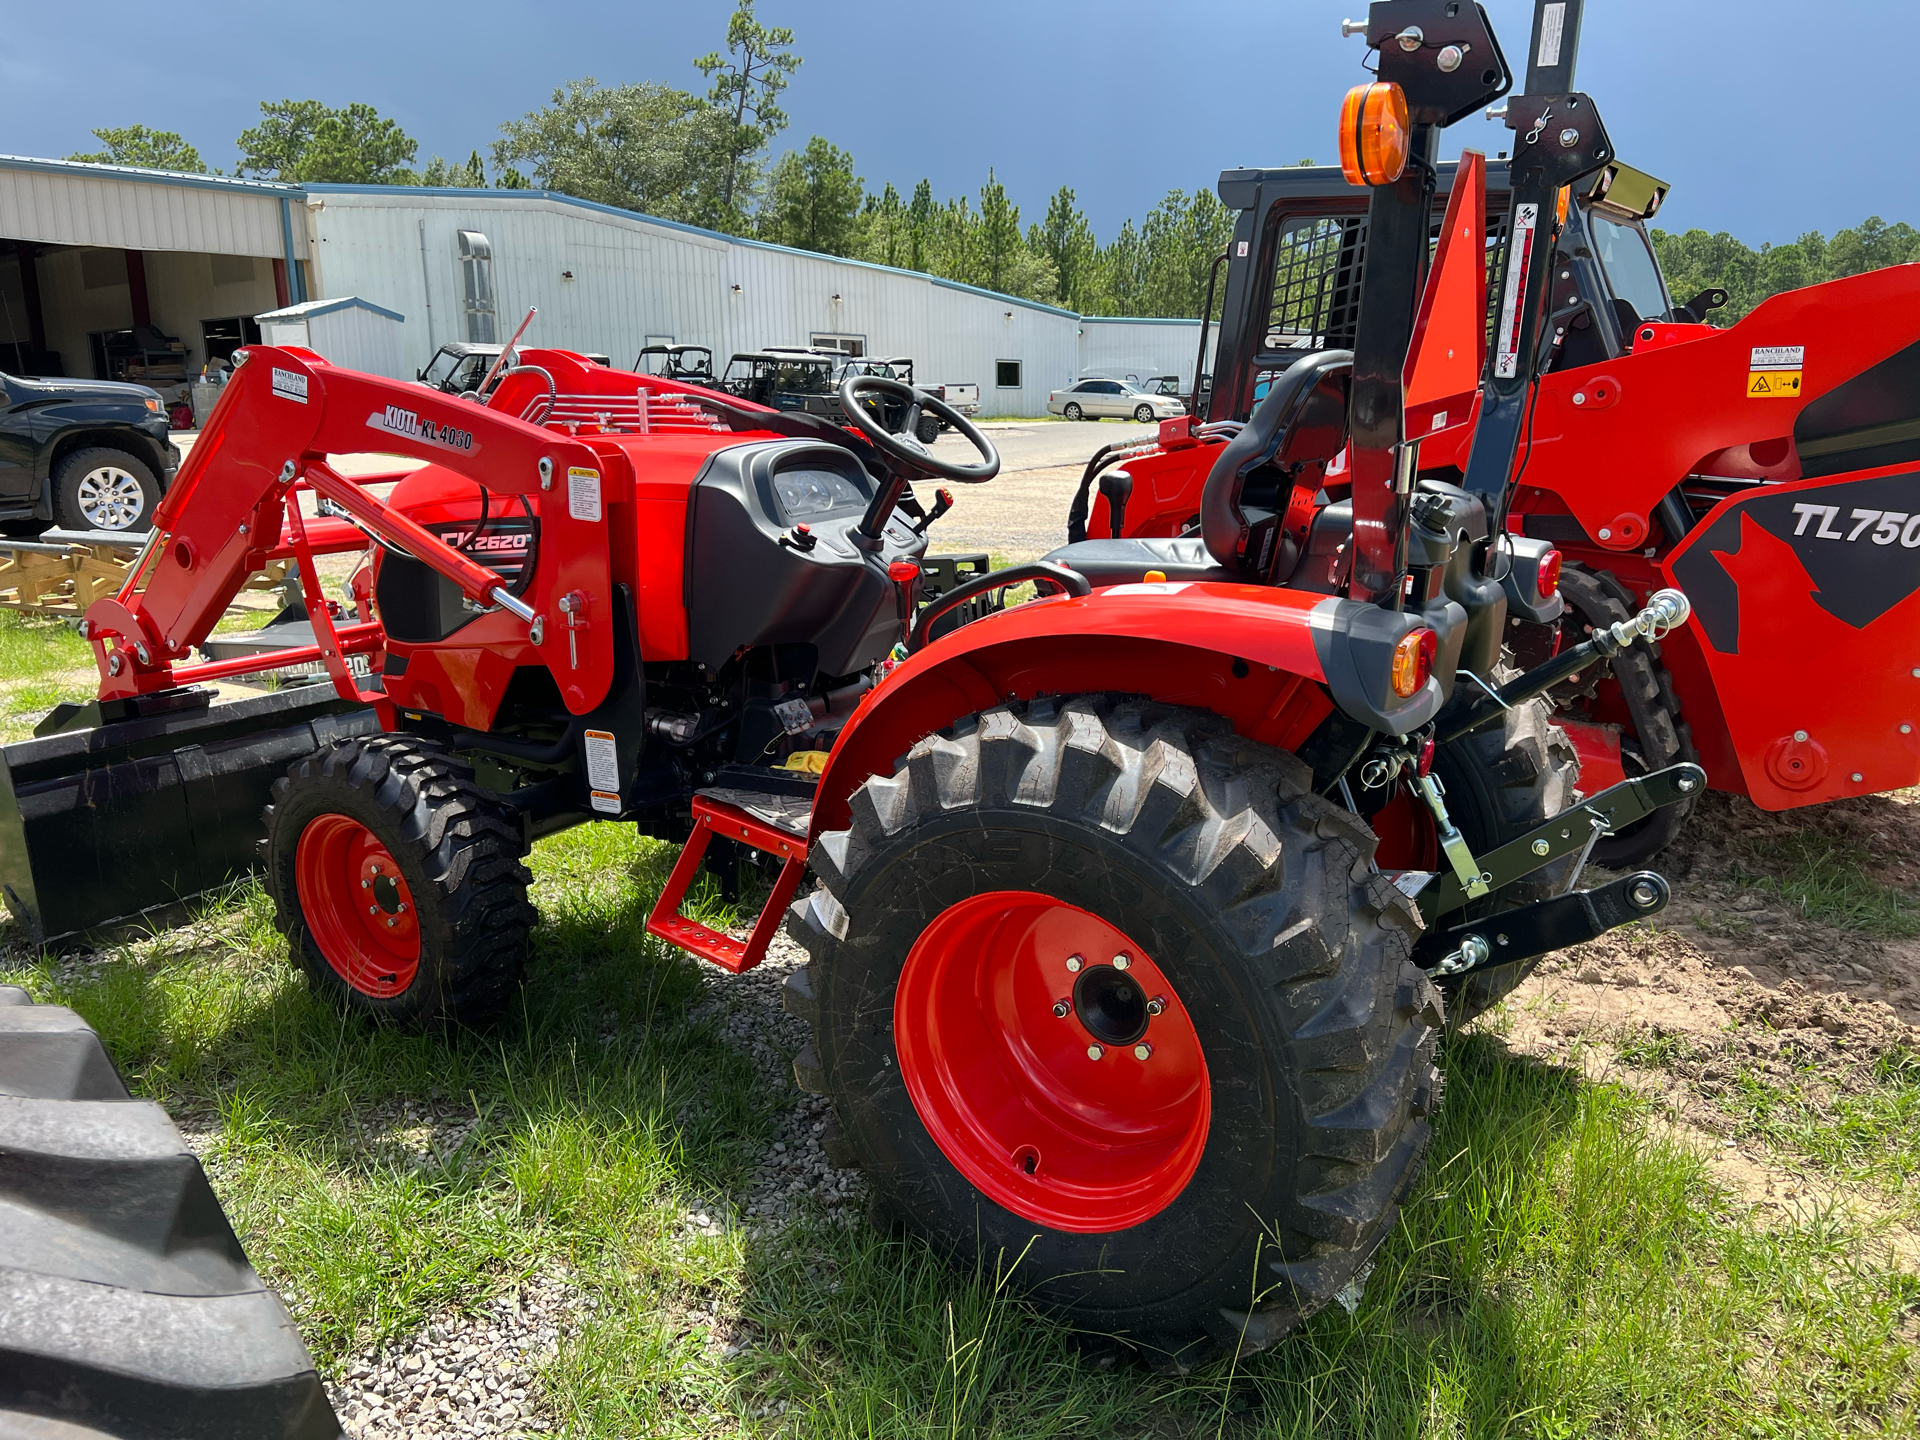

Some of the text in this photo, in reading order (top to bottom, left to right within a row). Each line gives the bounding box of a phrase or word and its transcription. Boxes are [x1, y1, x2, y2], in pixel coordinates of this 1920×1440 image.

[1511, 254, 1530, 348] DANGER
[1755, 347, 1801, 355] RANCHLAND
[274, 368, 306, 384] RANCHLAND
[383, 403, 473, 451] KIOTI KL 4030
